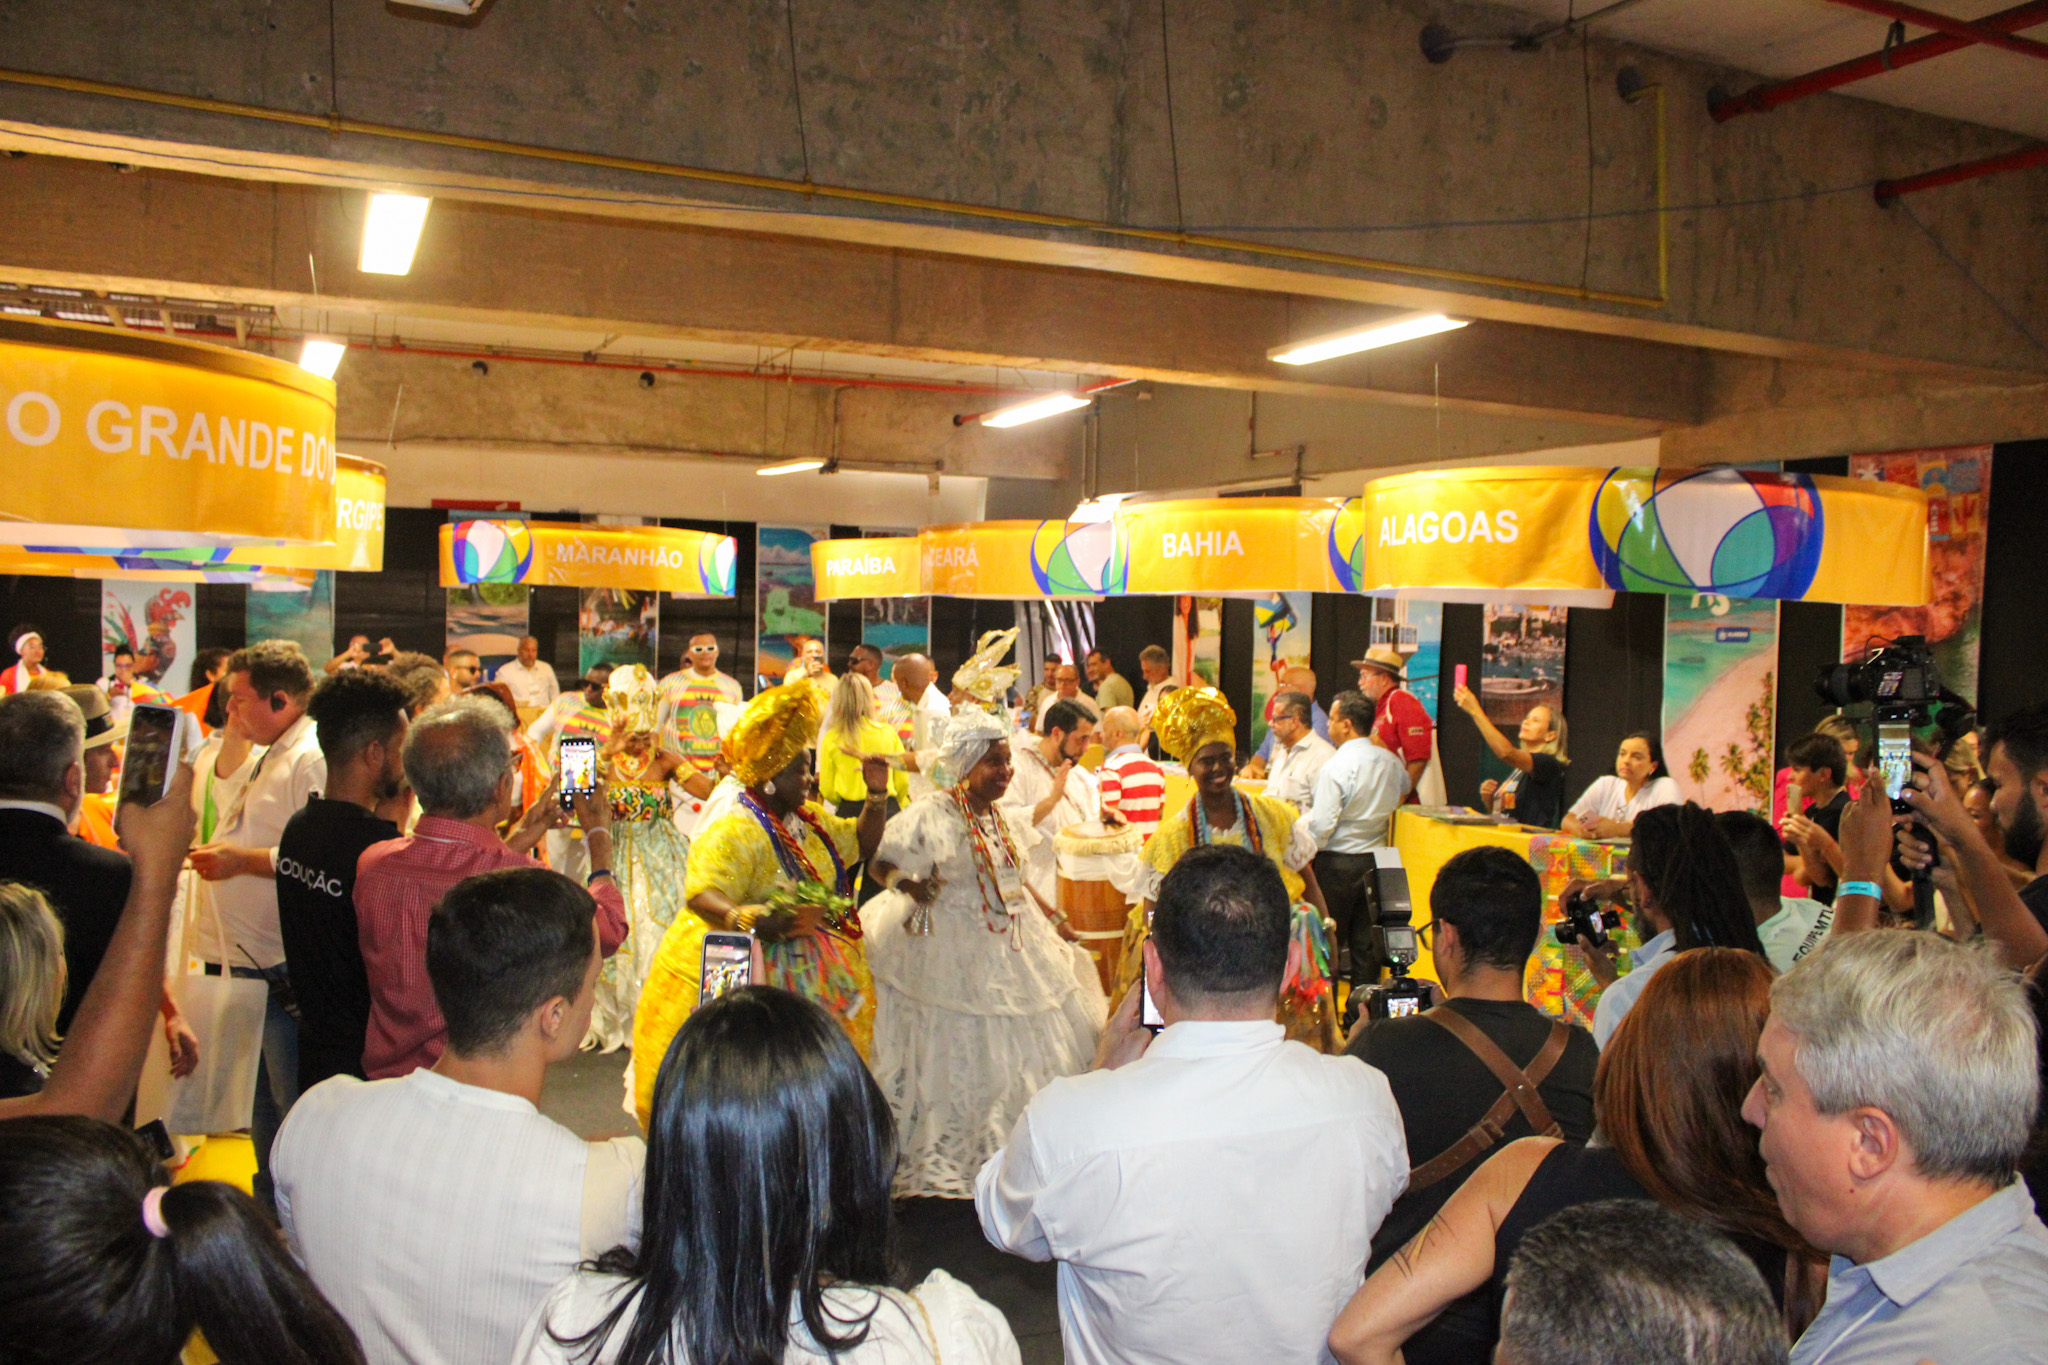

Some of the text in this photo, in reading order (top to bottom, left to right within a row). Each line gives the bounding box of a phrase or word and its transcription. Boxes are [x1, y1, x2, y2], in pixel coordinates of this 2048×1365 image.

[86, 400, 295, 474] GRANDE
[336, 497, 384, 532] RGIPE
[1378, 510, 1520, 547] ALAGOAS
[556, 545, 683, 569] MARANHÃO
[927, 542, 979, 567] CEARÁ
[1162, 530, 1245, 558] BAHIA
[826, 553, 896, 576] PARAÍBA
